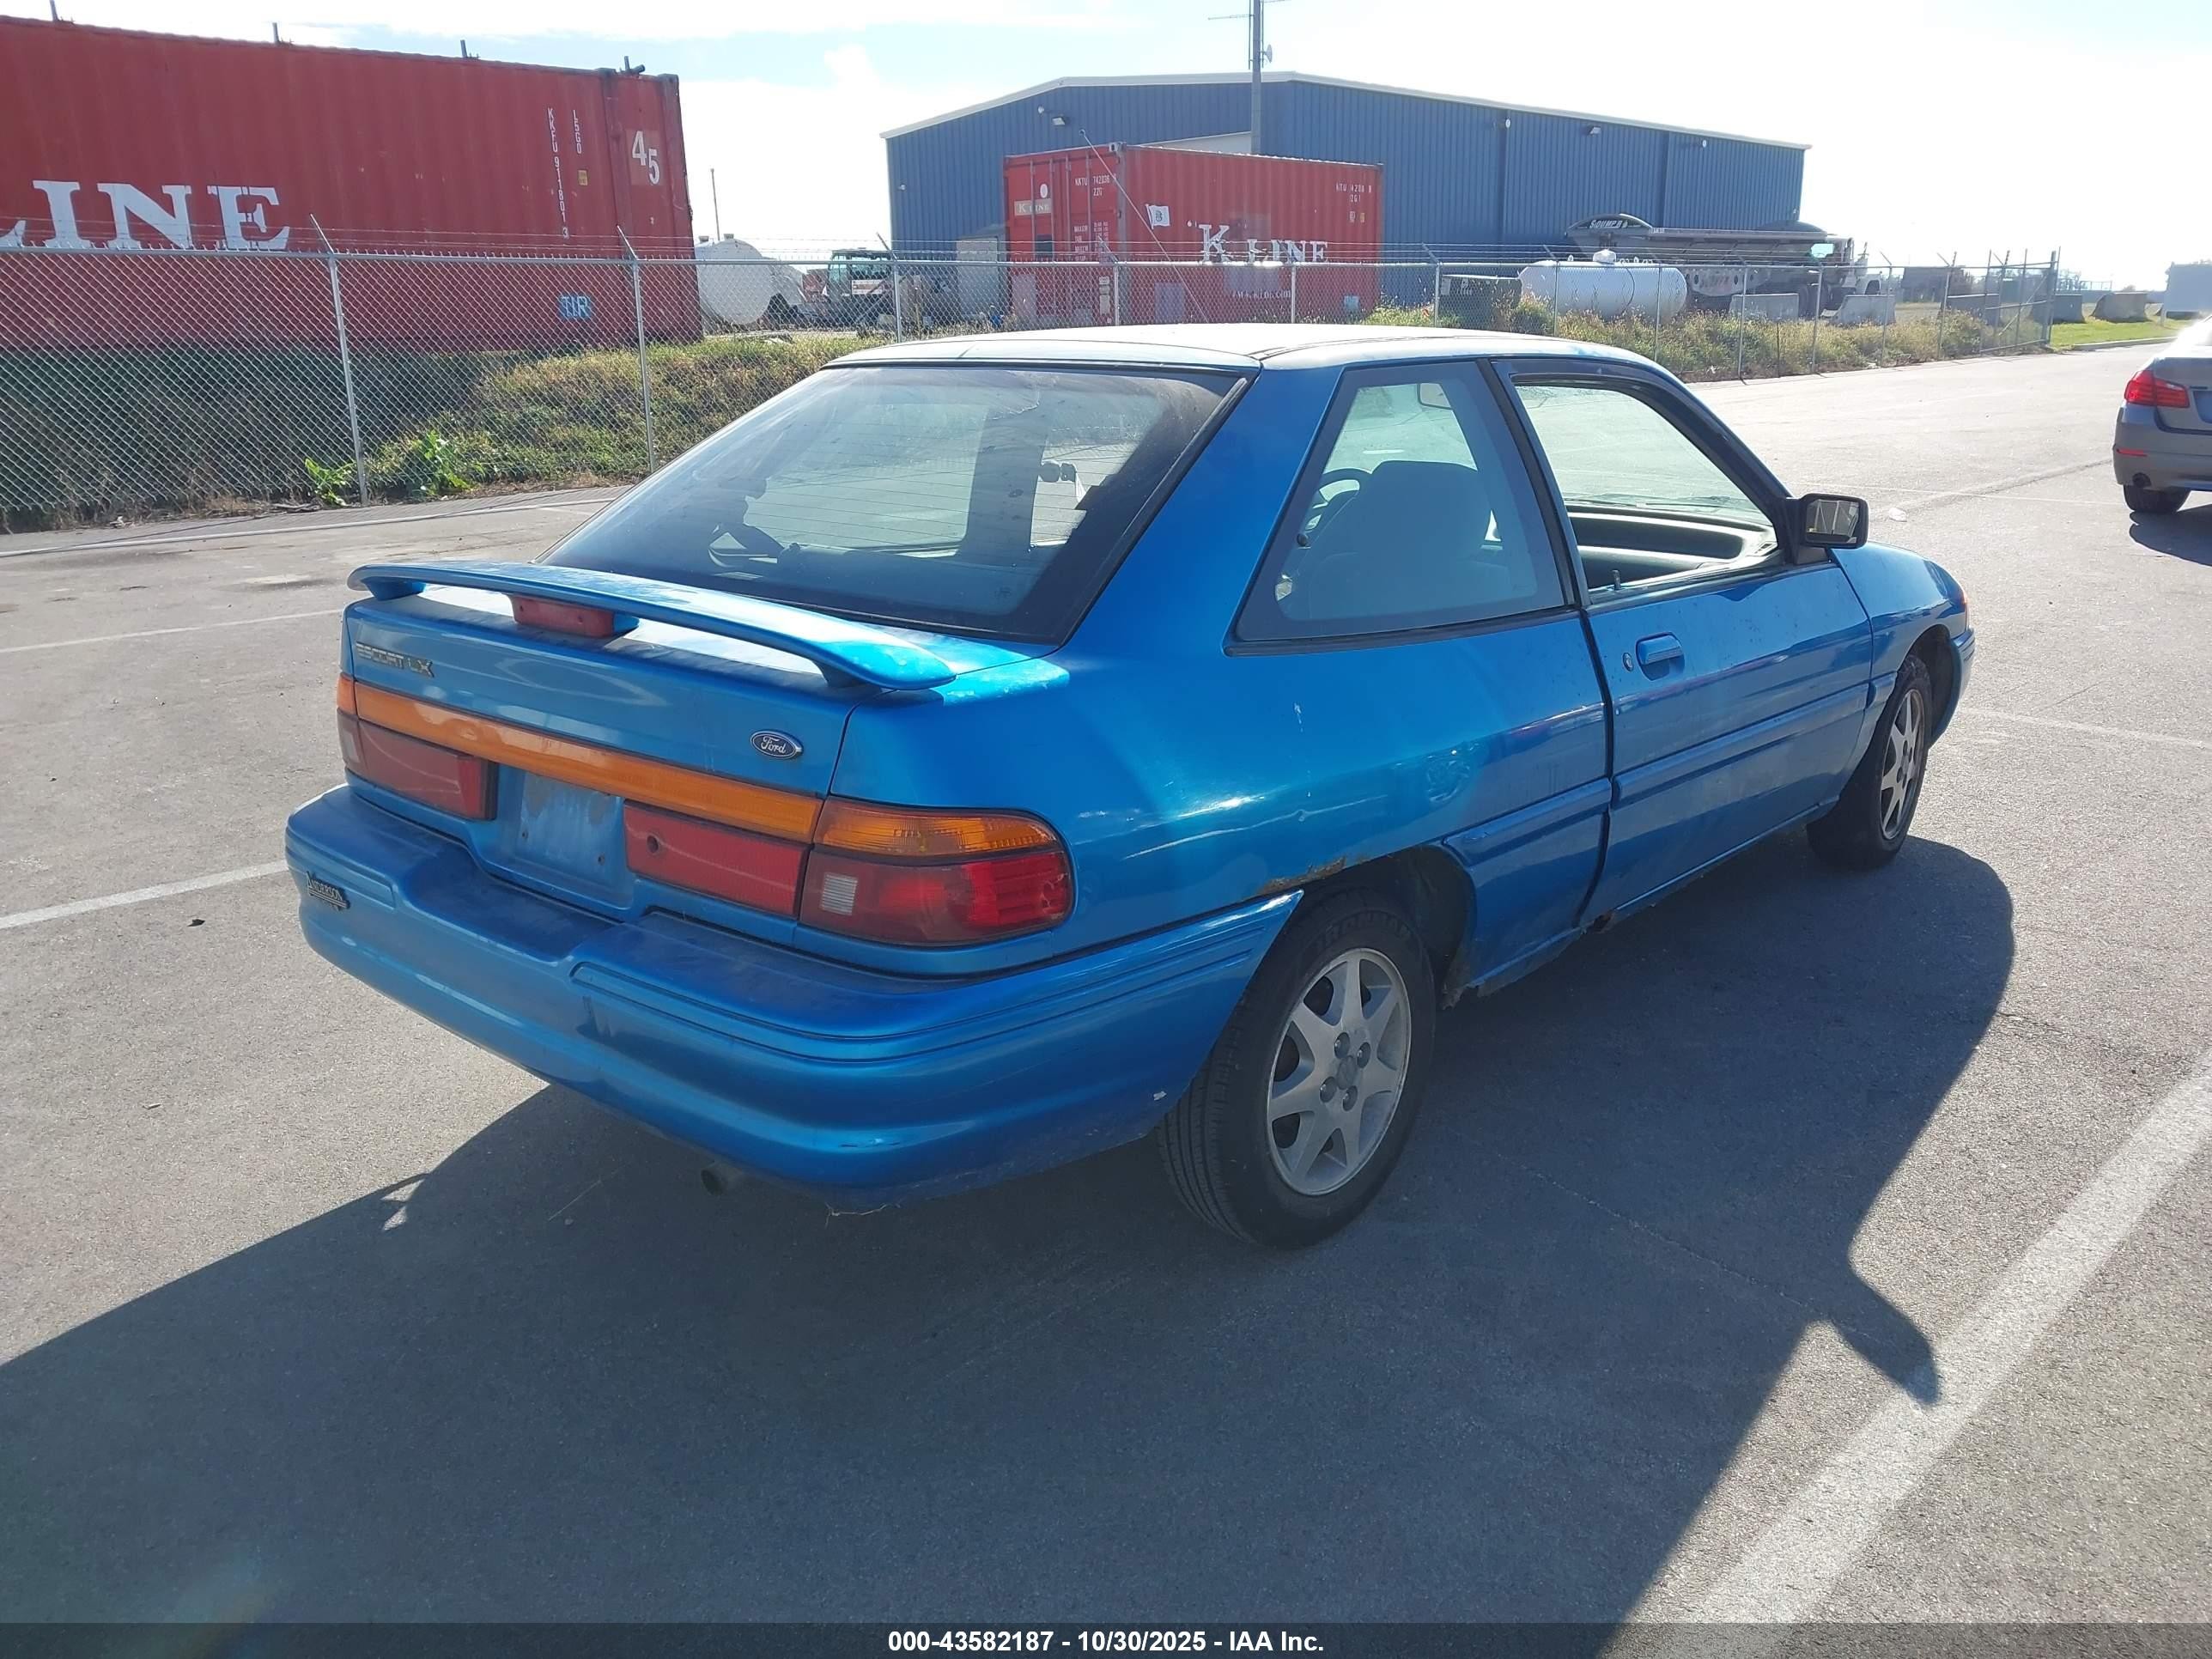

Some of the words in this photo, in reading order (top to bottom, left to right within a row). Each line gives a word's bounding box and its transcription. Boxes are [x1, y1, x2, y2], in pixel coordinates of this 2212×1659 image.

[632, 131, 660, 185] 45
[1199, 224, 1231, 263] K
[761, 736, 787, 754] Ford
